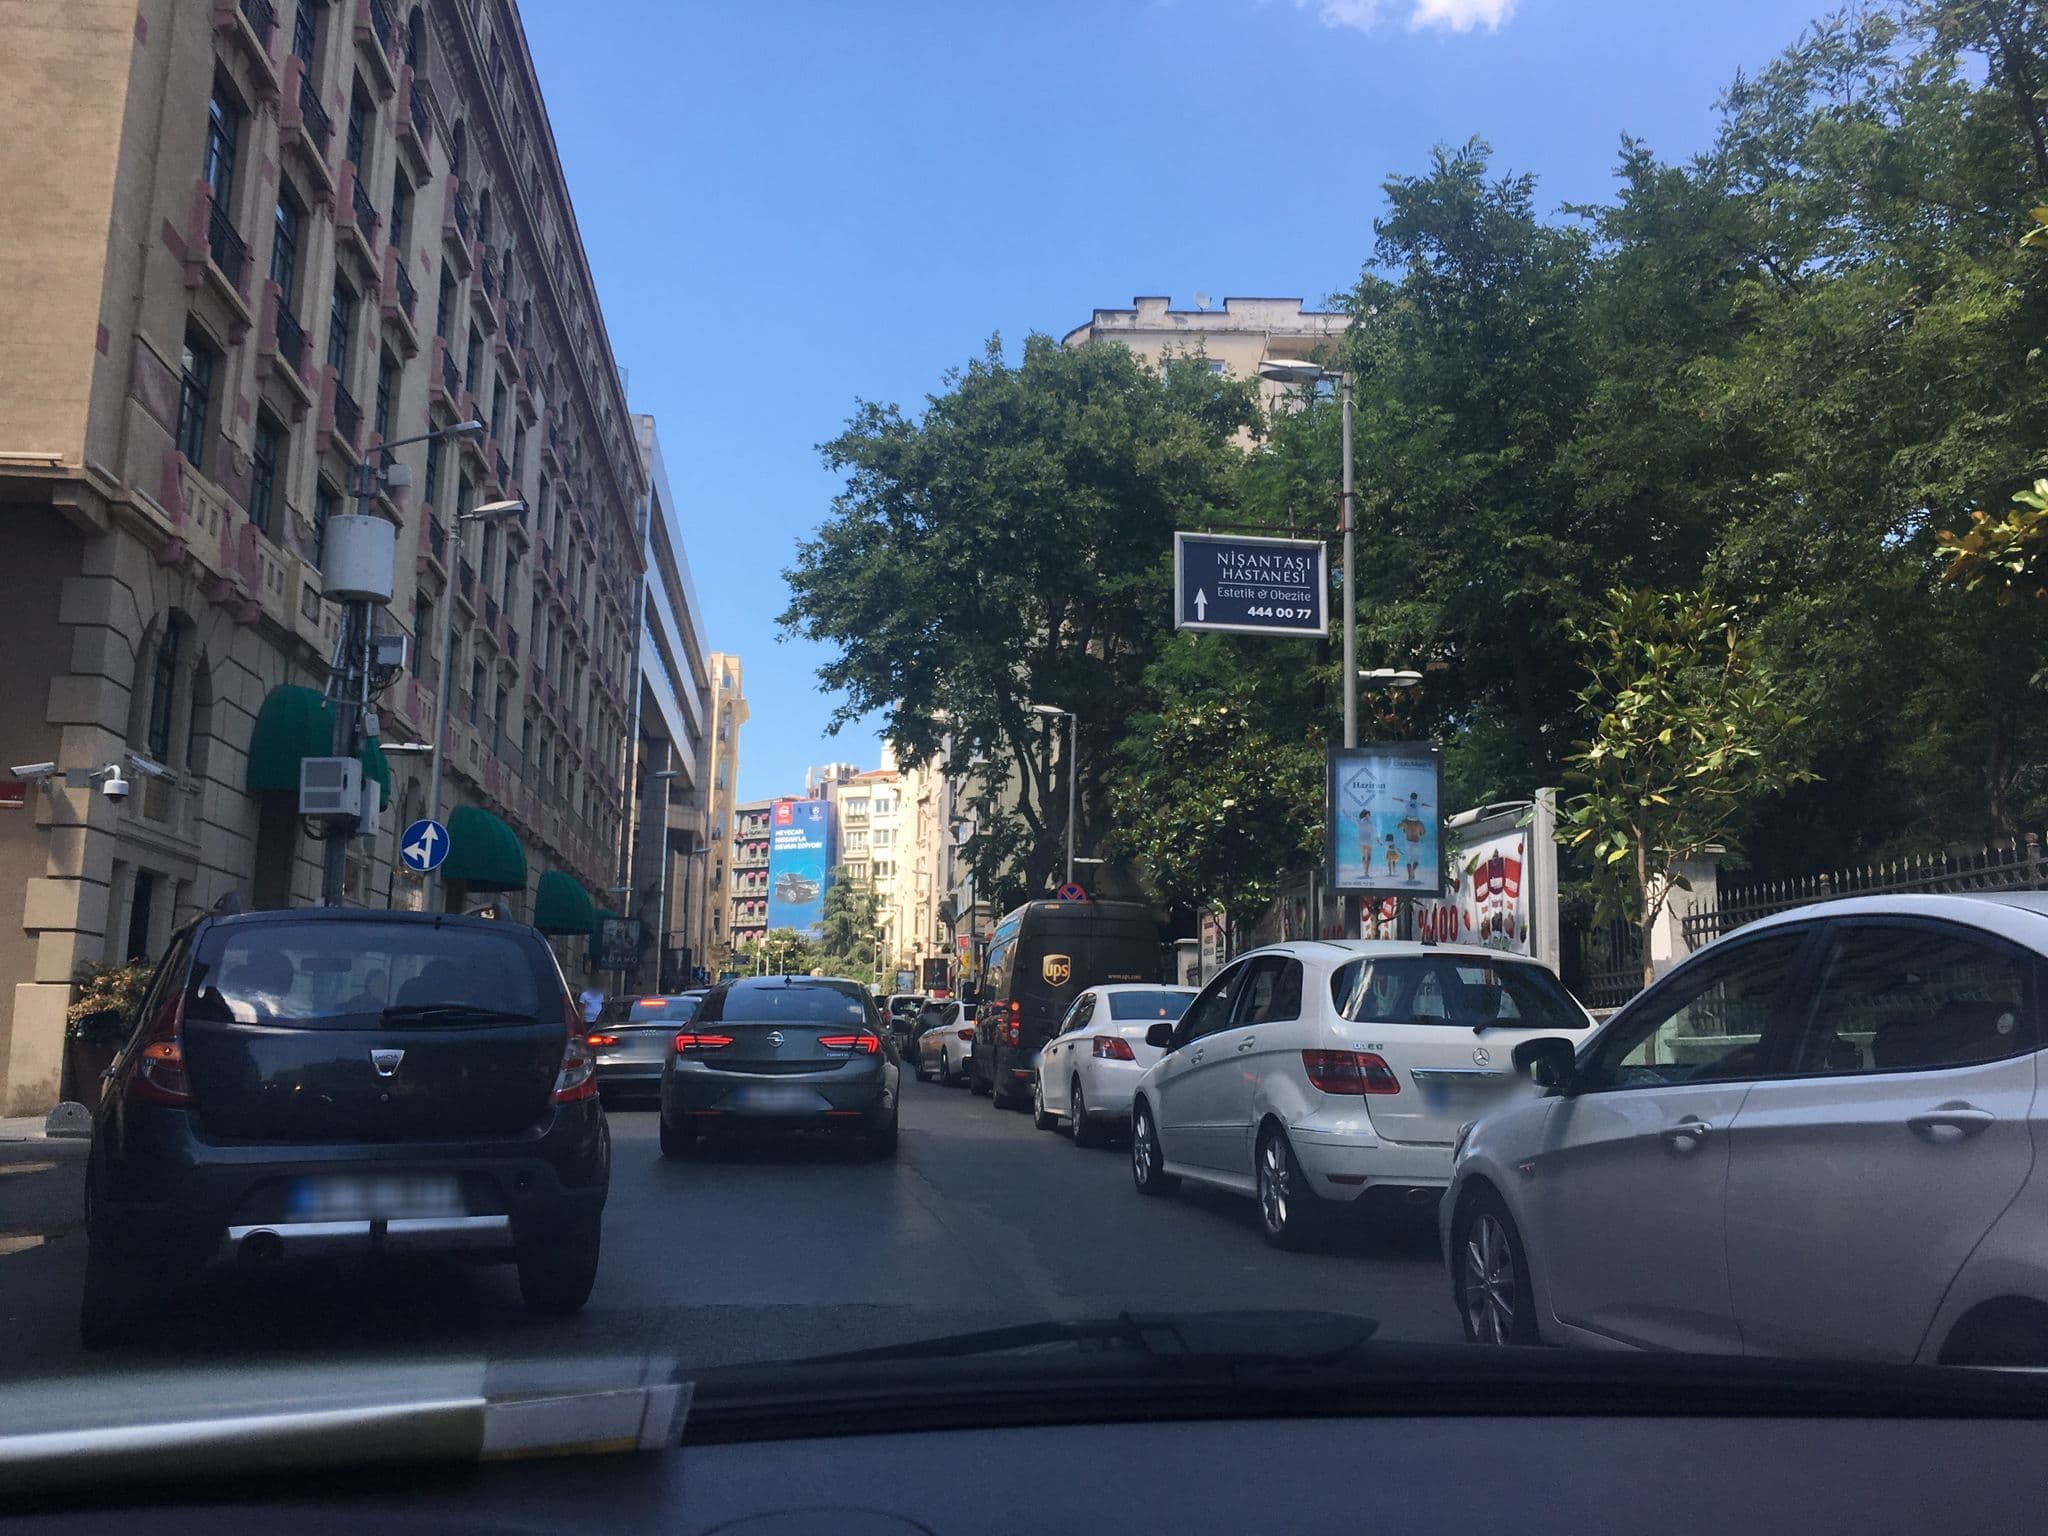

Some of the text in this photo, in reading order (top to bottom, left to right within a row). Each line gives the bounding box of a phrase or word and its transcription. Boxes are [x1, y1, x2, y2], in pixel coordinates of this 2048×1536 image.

[1217, 551, 1311, 571] NİŞANTAŞI
[1223, 567, 1305, 583] HASTANESİ
[1217, 587, 1311, 602] Estetik & Obezite
[1248, 606, 1312, 619] 444 00 77
[1045, 963, 1069, 982] ups
